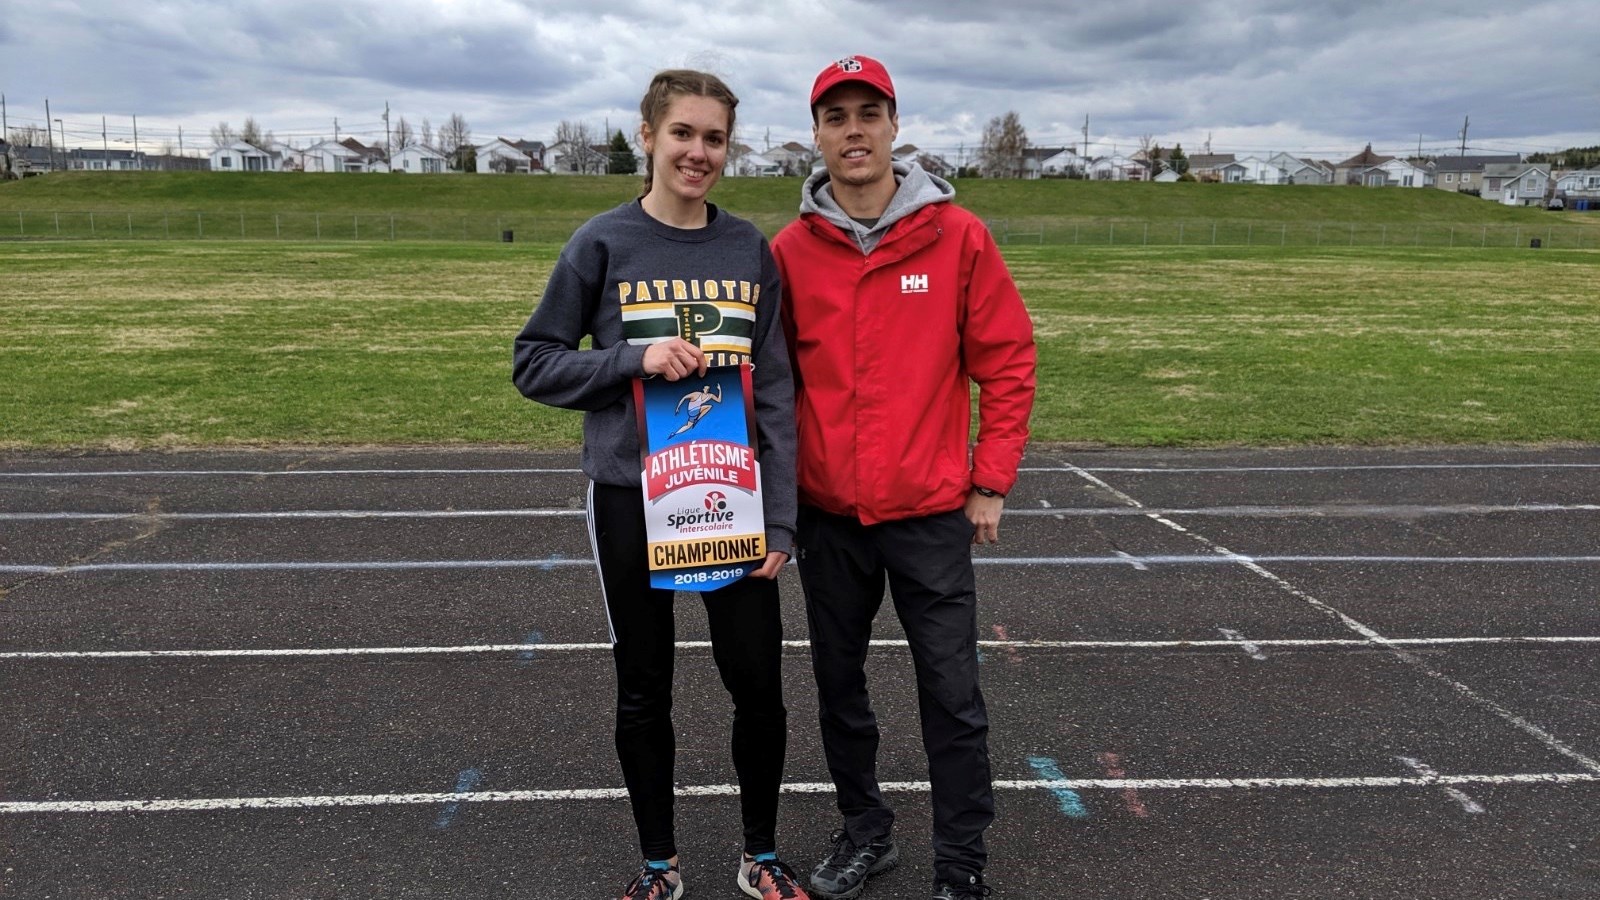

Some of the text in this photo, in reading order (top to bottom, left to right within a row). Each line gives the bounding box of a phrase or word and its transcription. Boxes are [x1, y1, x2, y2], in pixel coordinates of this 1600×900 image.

[901, 274, 928, 289] HH
[618, 280, 761, 304] PATRIOTES
[651, 440, 750, 479] ATHLÉTISME
[665, 465, 738, 489] JUVÉNILE
[667, 510, 734, 529] Sportive
[677, 506, 701, 515] Ligue
[679, 523, 734, 534] interscolaire
[654, 537, 761, 566] CHAMPIONNE
[674, 568, 744, 585] 2018-2019
